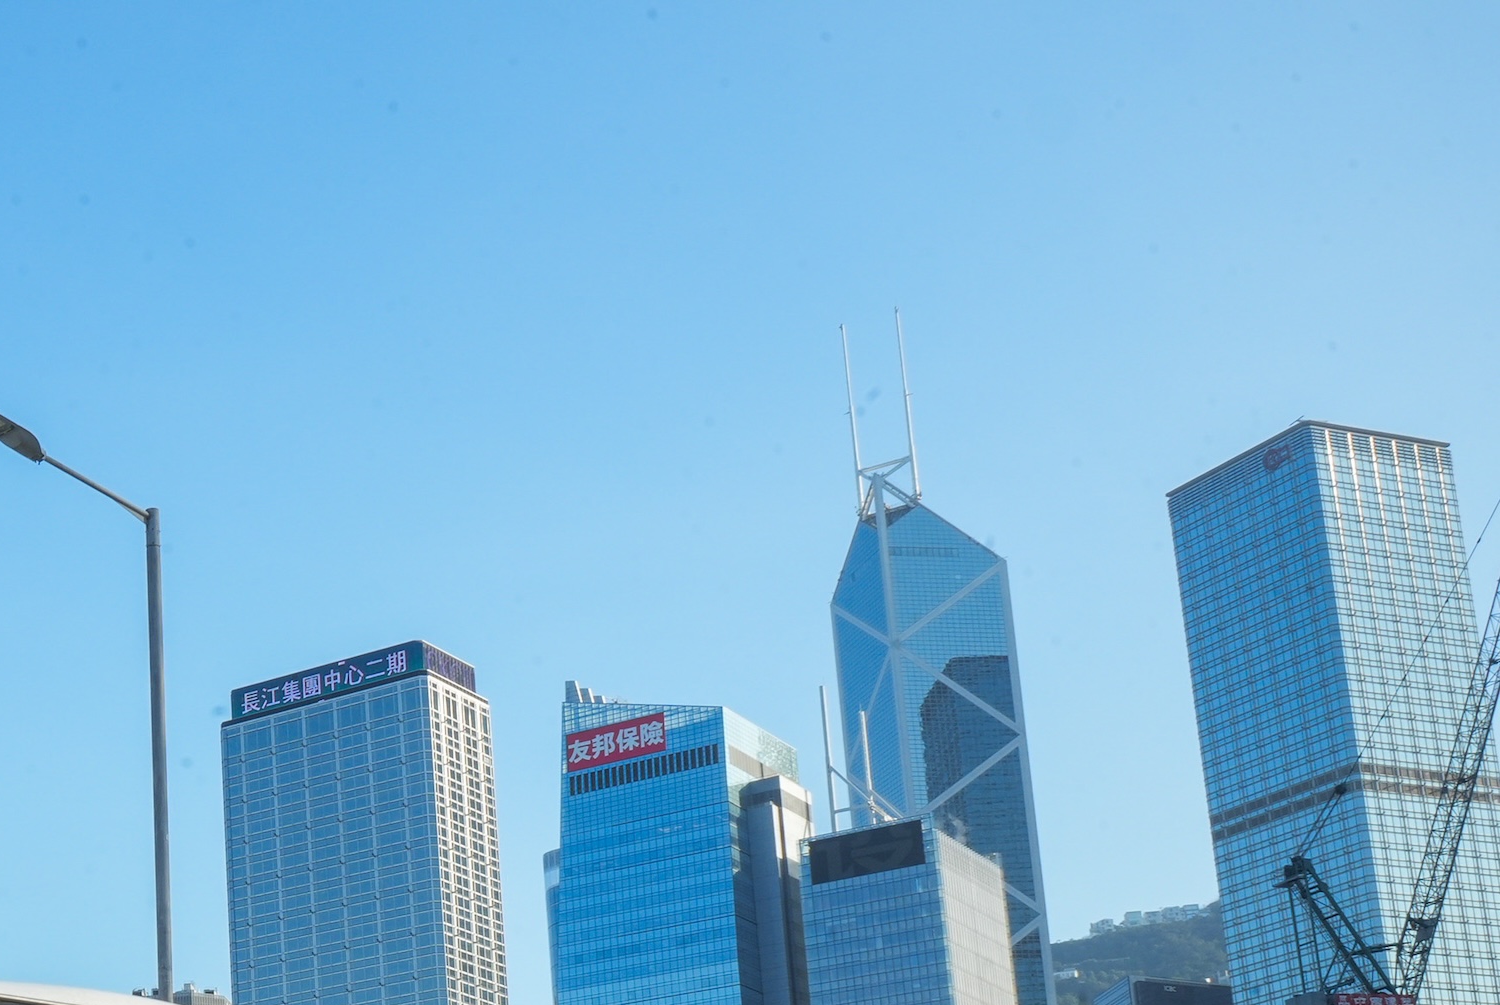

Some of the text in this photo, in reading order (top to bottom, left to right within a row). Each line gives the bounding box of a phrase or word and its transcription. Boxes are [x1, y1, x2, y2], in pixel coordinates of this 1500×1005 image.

[241, 649, 407, 715] 長江集團中心二期
[567, 721, 665, 764] 友邦保險
